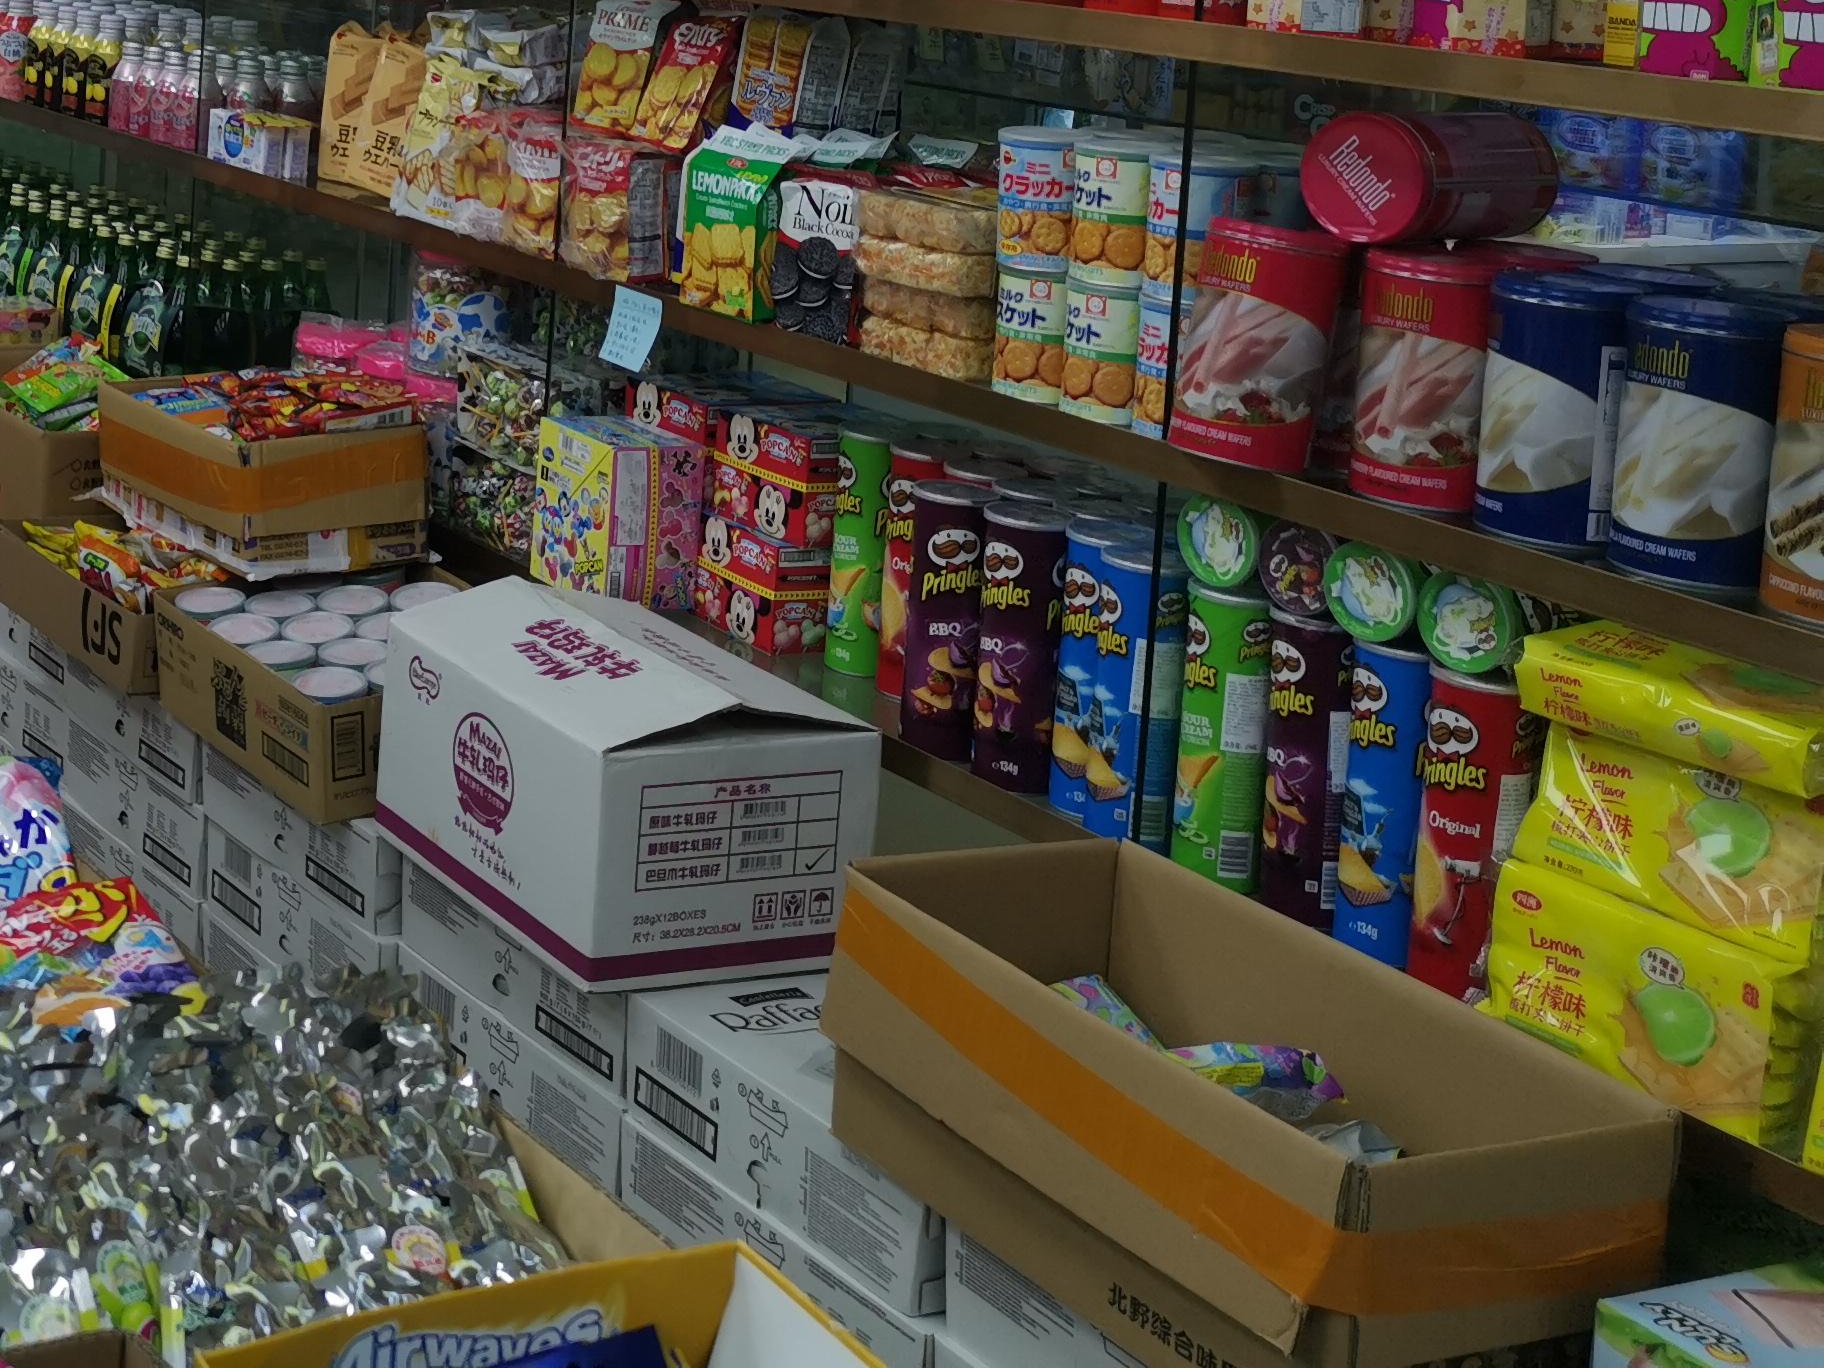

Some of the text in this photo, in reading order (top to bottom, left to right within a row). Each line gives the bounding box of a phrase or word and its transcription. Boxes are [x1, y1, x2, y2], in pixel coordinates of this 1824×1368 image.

[597, 10, 652, 32] PRIME
[1024, 161, 1051, 176] ミニ
[1327, 135, 1395, 212] Redondo
[1002, 174, 1075, 199] クラッカー
[792, 216, 824, 234] Black
[1652, 373, 1686, 390] WAFERS
[922, 564, 982, 601] Pringle
[928, 623, 962, 637] BBQ
[1540, 667, 1583, 688] Lemon
[469, 722, 503, 758] MAZAI
[1423, 753, 1486, 790] Pringles
[1580, 753, 1634, 779] Lemon
[715, 783, 771, 798] 产品名称
[1429, 810, 1481, 838] Original
[633, 910, 706, 927] 238gX12BOXES
[1529, 928, 1585, 959] Lemon
[1515, 972, 1586, 1018] 柠檬味
